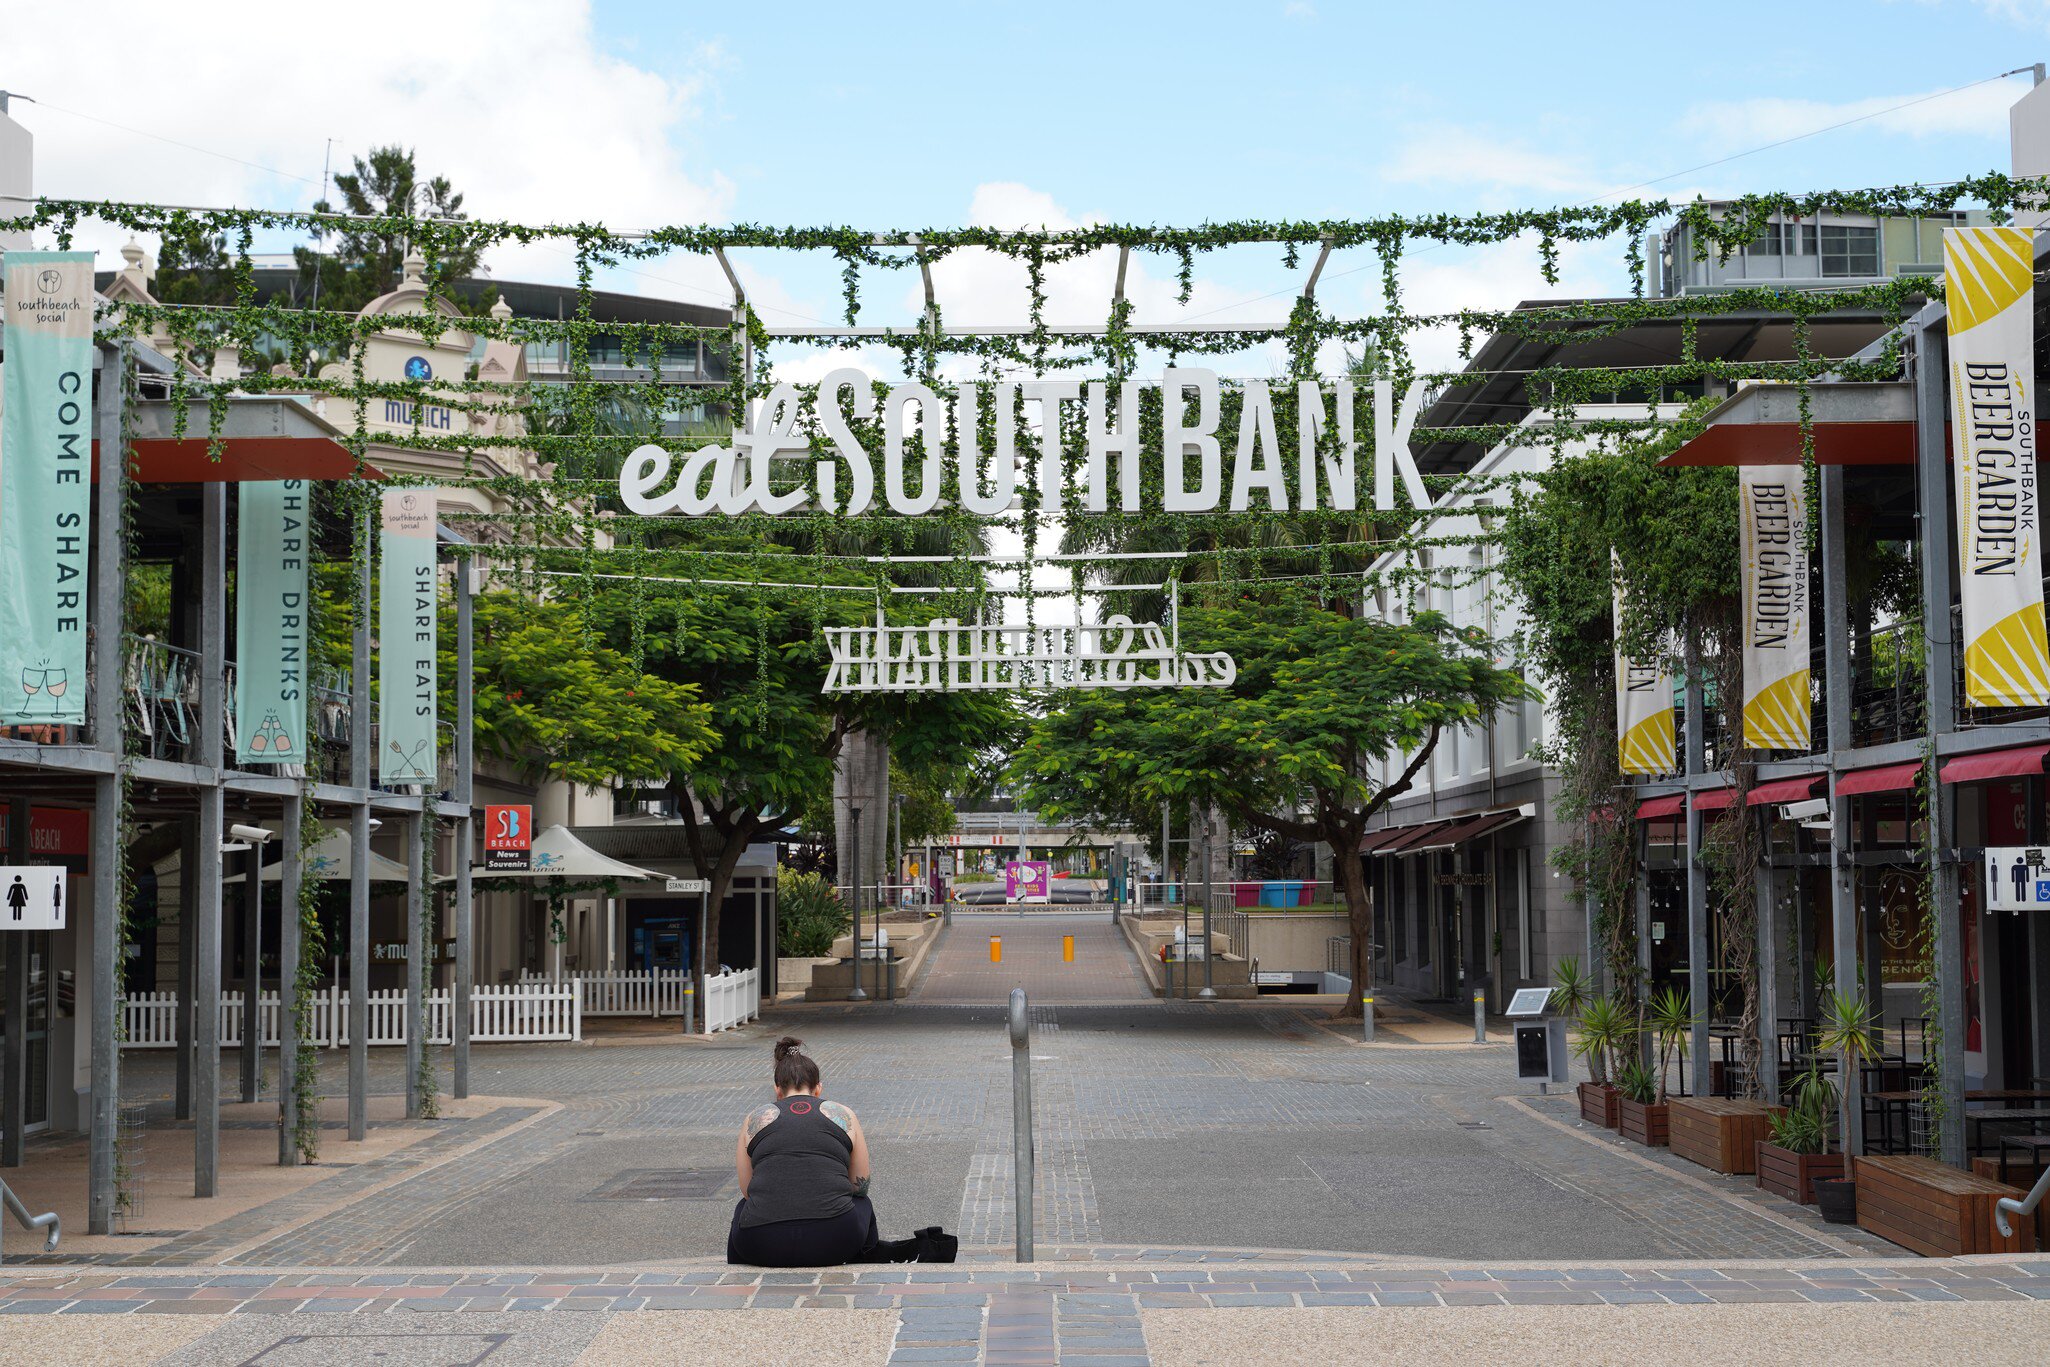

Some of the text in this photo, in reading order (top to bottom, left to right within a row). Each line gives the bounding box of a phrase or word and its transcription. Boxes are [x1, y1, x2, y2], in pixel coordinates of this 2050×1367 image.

[18, 298, 80, 311] southbeach
[36, 311, 66, 323] social
[1965, 361, 2017, 577] BEER GARDEN
[2018, 410, 2034, 530] SOUTHBANK
[56, 371, 82, 632] COME SHARE
[388, 513, 429, 522] southbeach
[1752, 483, 1792, 650] BEER GARDEN
[281, 479, 301, 701] SHARE DRINKS
[415, 566, 431, 716] SHARE EATS
[497, 809, 520, 838] SB
[35, 828, 61, 850] BEACH
[491, 840, 526, 848] BEACH
[488, 860, 527, 868] Souvenirs
[497, 850, 519, 858] News
[668, 882, 693, 890] STANLEY
